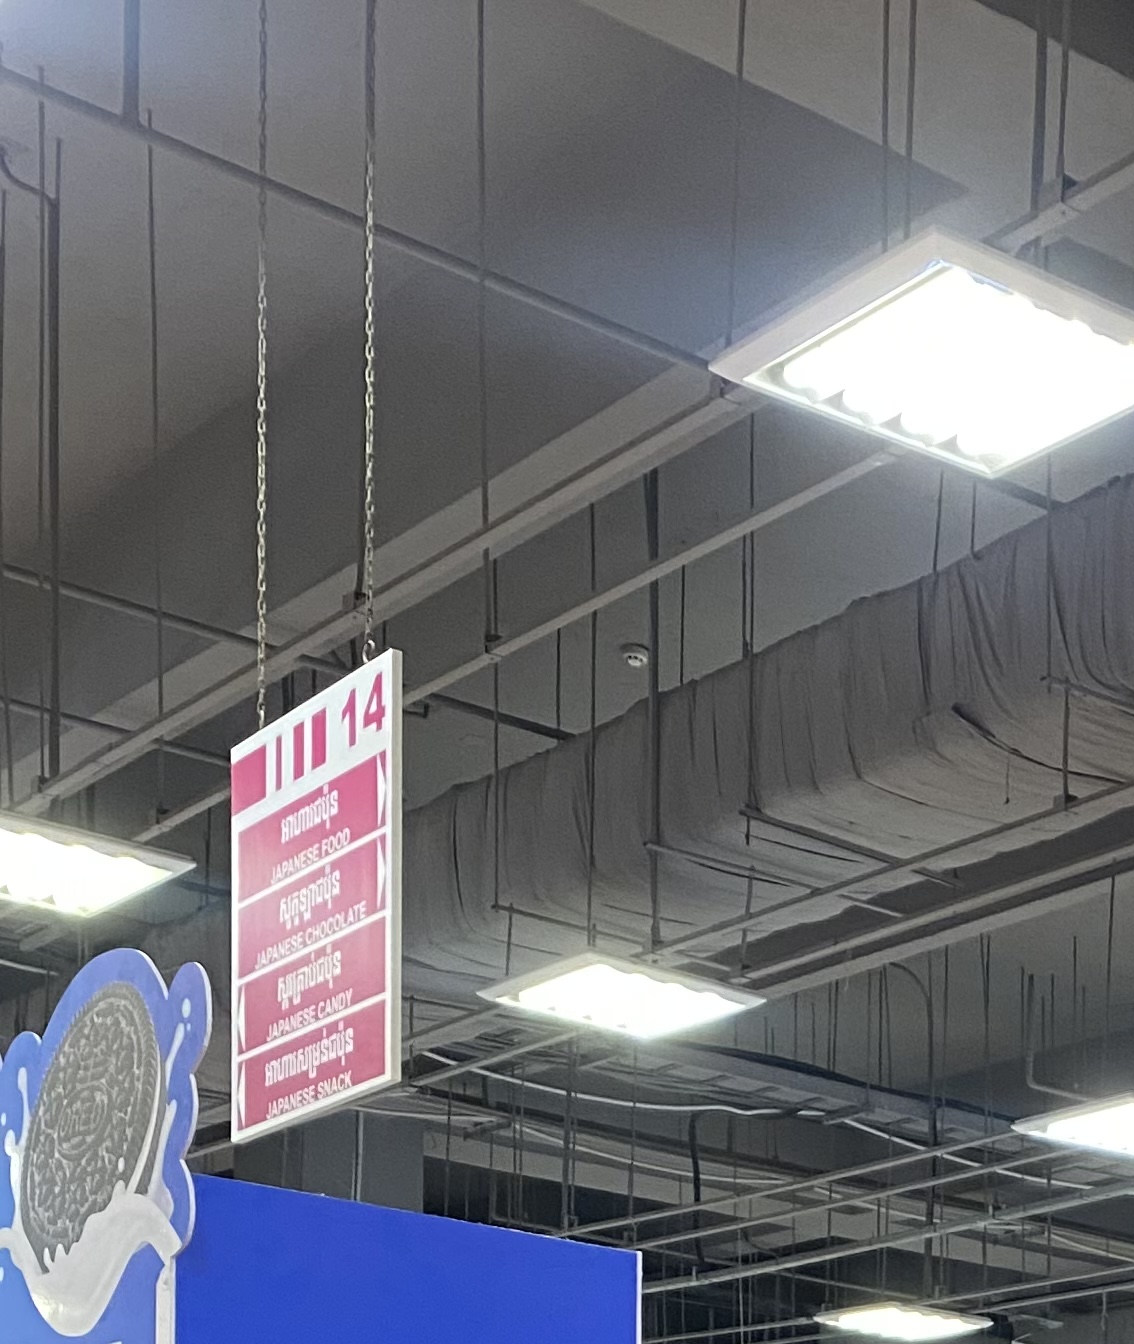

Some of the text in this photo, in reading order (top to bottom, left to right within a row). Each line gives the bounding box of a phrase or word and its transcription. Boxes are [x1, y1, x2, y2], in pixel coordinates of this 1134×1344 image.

[341, 671, 386, 748] 14
[270, 827, 351, 885] JAPANESE FOOD
[255, 900, 368, 971] JAPANESE CHOCOLATE
[266, 987, 353, 1042] JAPANESE CANDY
[265, 1069, 353, 1121] JAPANESE SNACK
